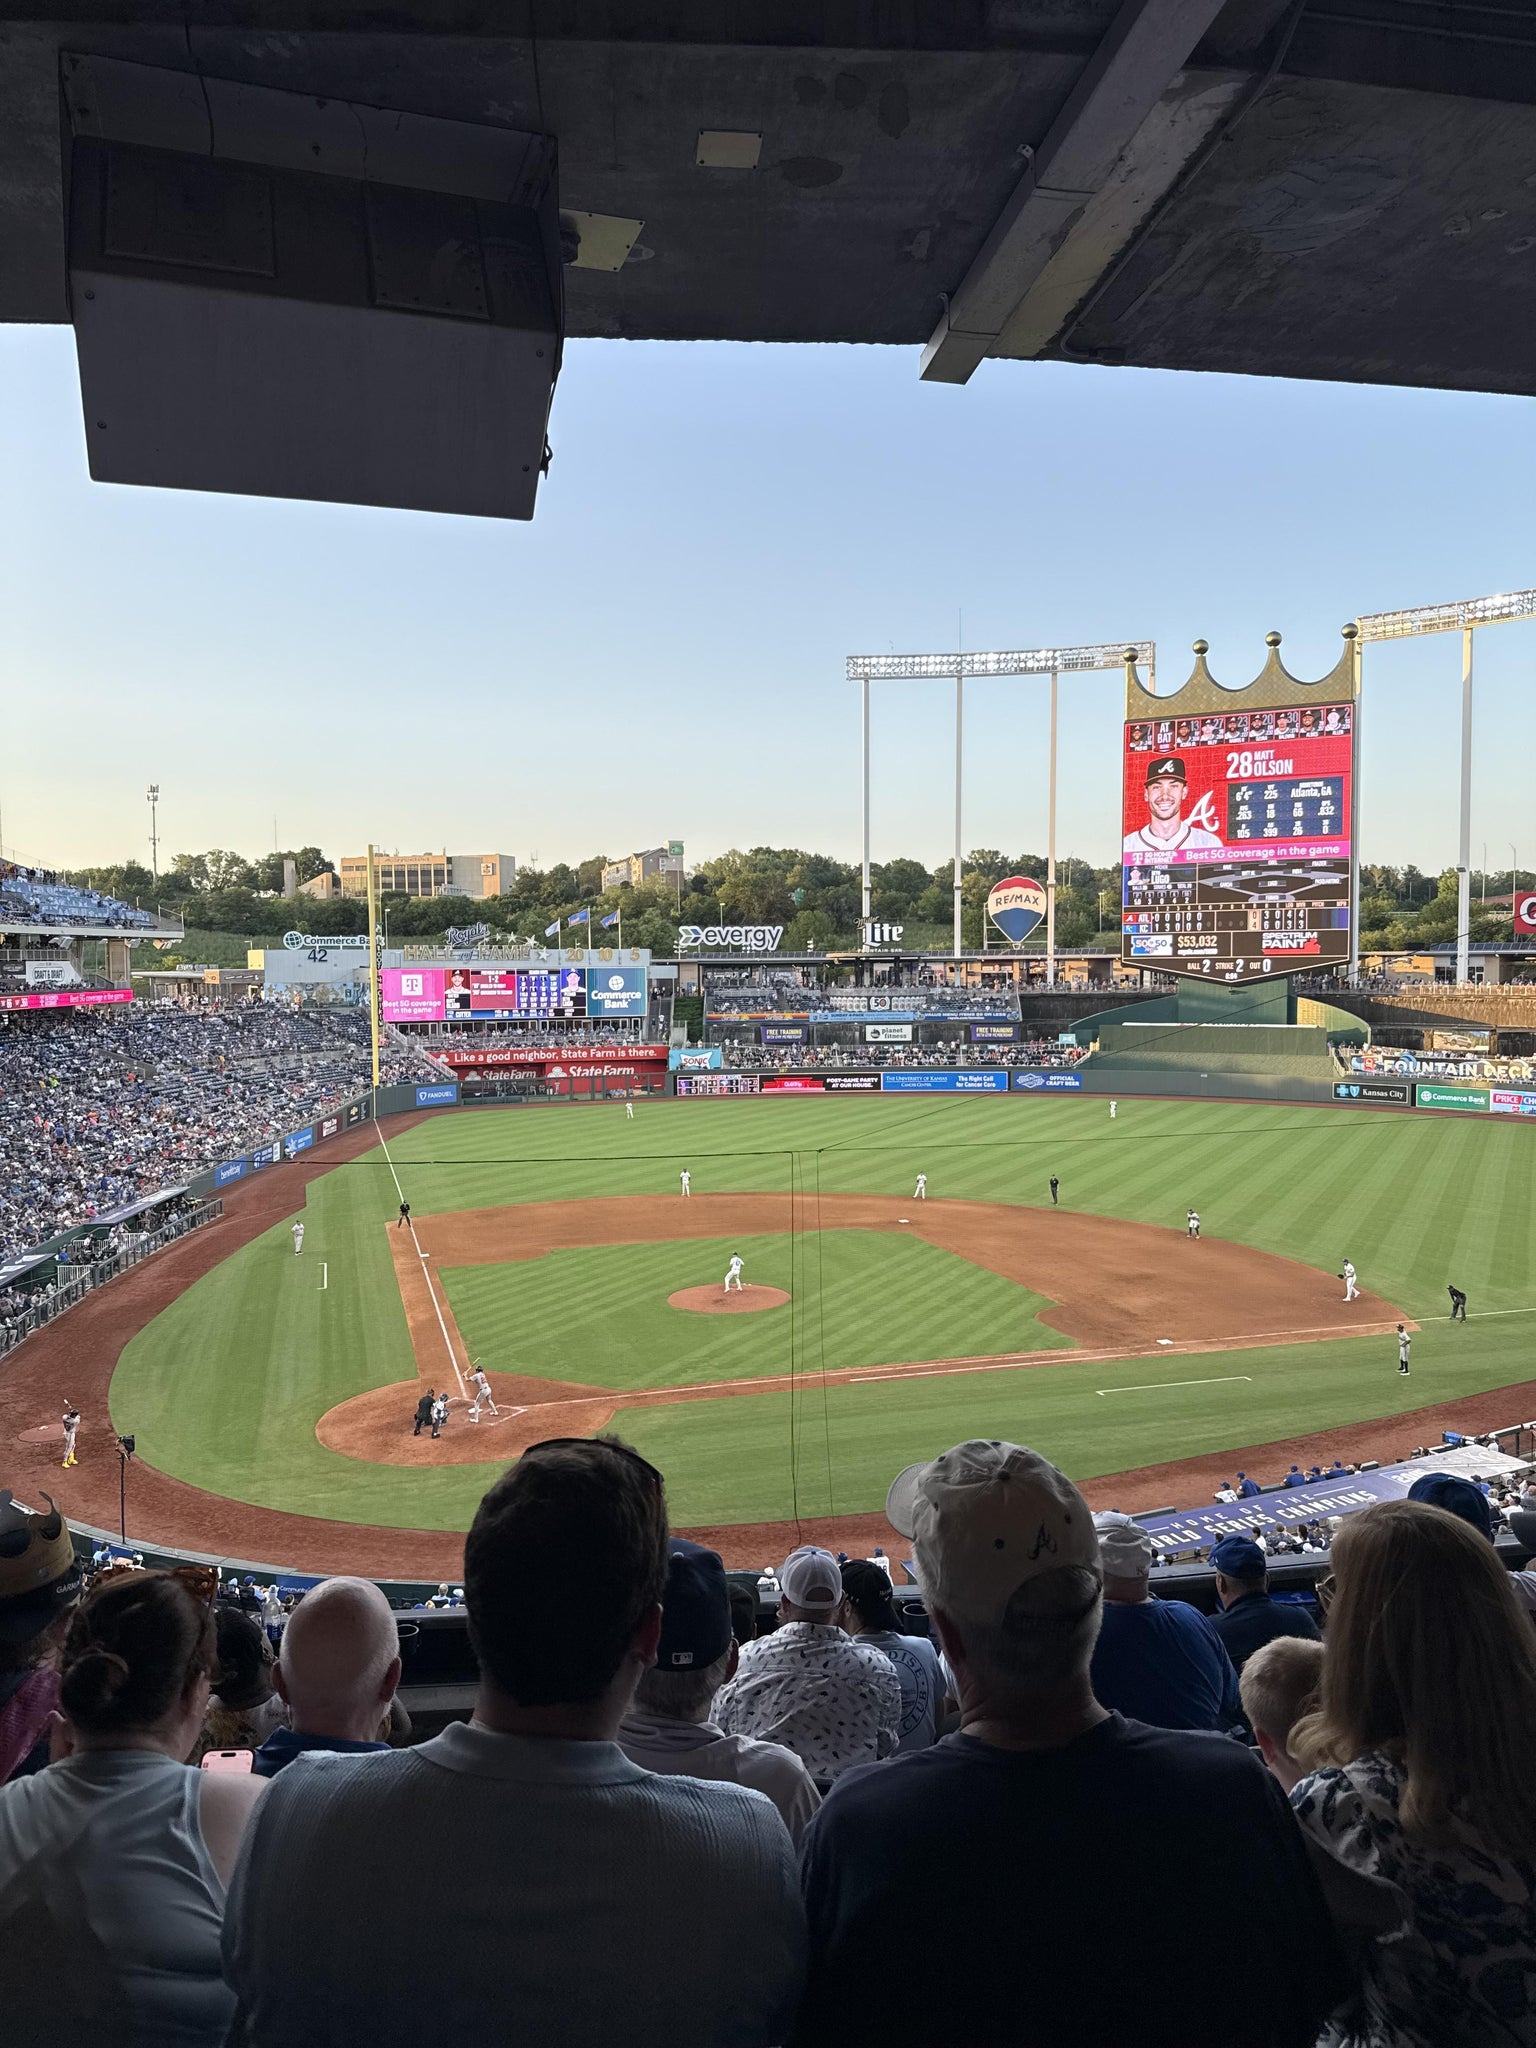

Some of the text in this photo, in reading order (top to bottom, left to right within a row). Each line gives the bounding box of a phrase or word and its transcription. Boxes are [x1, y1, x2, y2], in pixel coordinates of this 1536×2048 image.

[1214, 718, 1223, 729] 27
[1238, 716, 1248, 727] 23
[1262, 714, 1273, 725] 20
[1287, 712, 1298, 723] 30
[1160, 722, 1170, 732] AT
[1191, 720, 1199, 730] 13
[1157, 733, 1172, 743] BAT
[1226, 750, 1275, 779] 28 MATT
[1254, 759, 1293, 776] OLSON
[1264, 786, 1332, 800] 225 Atlanta, GA
[1236, 806, 1335, 820] .263 18 66 .832
[1237, 826, 1328, 838] 105 399 26 0
[1186, 846, 1340, 860] Best 5G coverage in the game
[1151, 875, 1170, 884] LUGO
[995, 894, 1040, 907] RE/MAX
[1138, 910, 1304, 922] ATL 3 0 4 4
[853, 916, 879, 930] Miller
[1139, 920, 1304, 933] KC 6 0 3 3
[446, 922, 490, 946] Royals
[704, 928, 782, 950] evergy
[864, 923, 903, 947] Lite
[1263, 932, 1317, 940] SPECTRUM
[304, 936, 385, 946] Commerce Bak
[1177, 936, 1217, 949] $53,032
[1262, 939, 1306, 949] PAINT
[307, 949, 328, 963] 42
[404, 945, 530, 963] HALL of FAME
[566, 948, 584, 962] 20
[598, 948, 613, 961] 10
[631, 947, 640, 961] 5
[1187, 962, 1200, 970] BALL
[1202, 960, 1210, 972] 2
[1236, 959, 1244, 972] 2
[1263, 959, 1271, 972] 0
[34, 970, 47, 979] CRAFT
[51, 970, 63, 978] DRAFT
[591, 991, 641, 999] Commerce
[411, 1000, 441, 1008] coverage
[604, 1000, 628, 1008] Bank
[454, 1047, 657, 1063] Like a good neighbor, State Farm is there.
[1384, 1062, 1534, 1078] FOUNTAIN DECK
[428, 1091, 453, 1099] FANDUEL
[1362, 1089, 1404, 1099] Kansas City
[1432, 1094, 1467, 1102] Commerce
[1496, 1094, 1519, 1103] PRICE
[1461, 1451, 1492, 1462] KC
[1170, 1494, 1314, 1529] HOME OF THE
[1150, 1490, 1378, 1548] ORLD SERIES CHAMPIONS
[903, 1691, 927, 1730] CLUB
